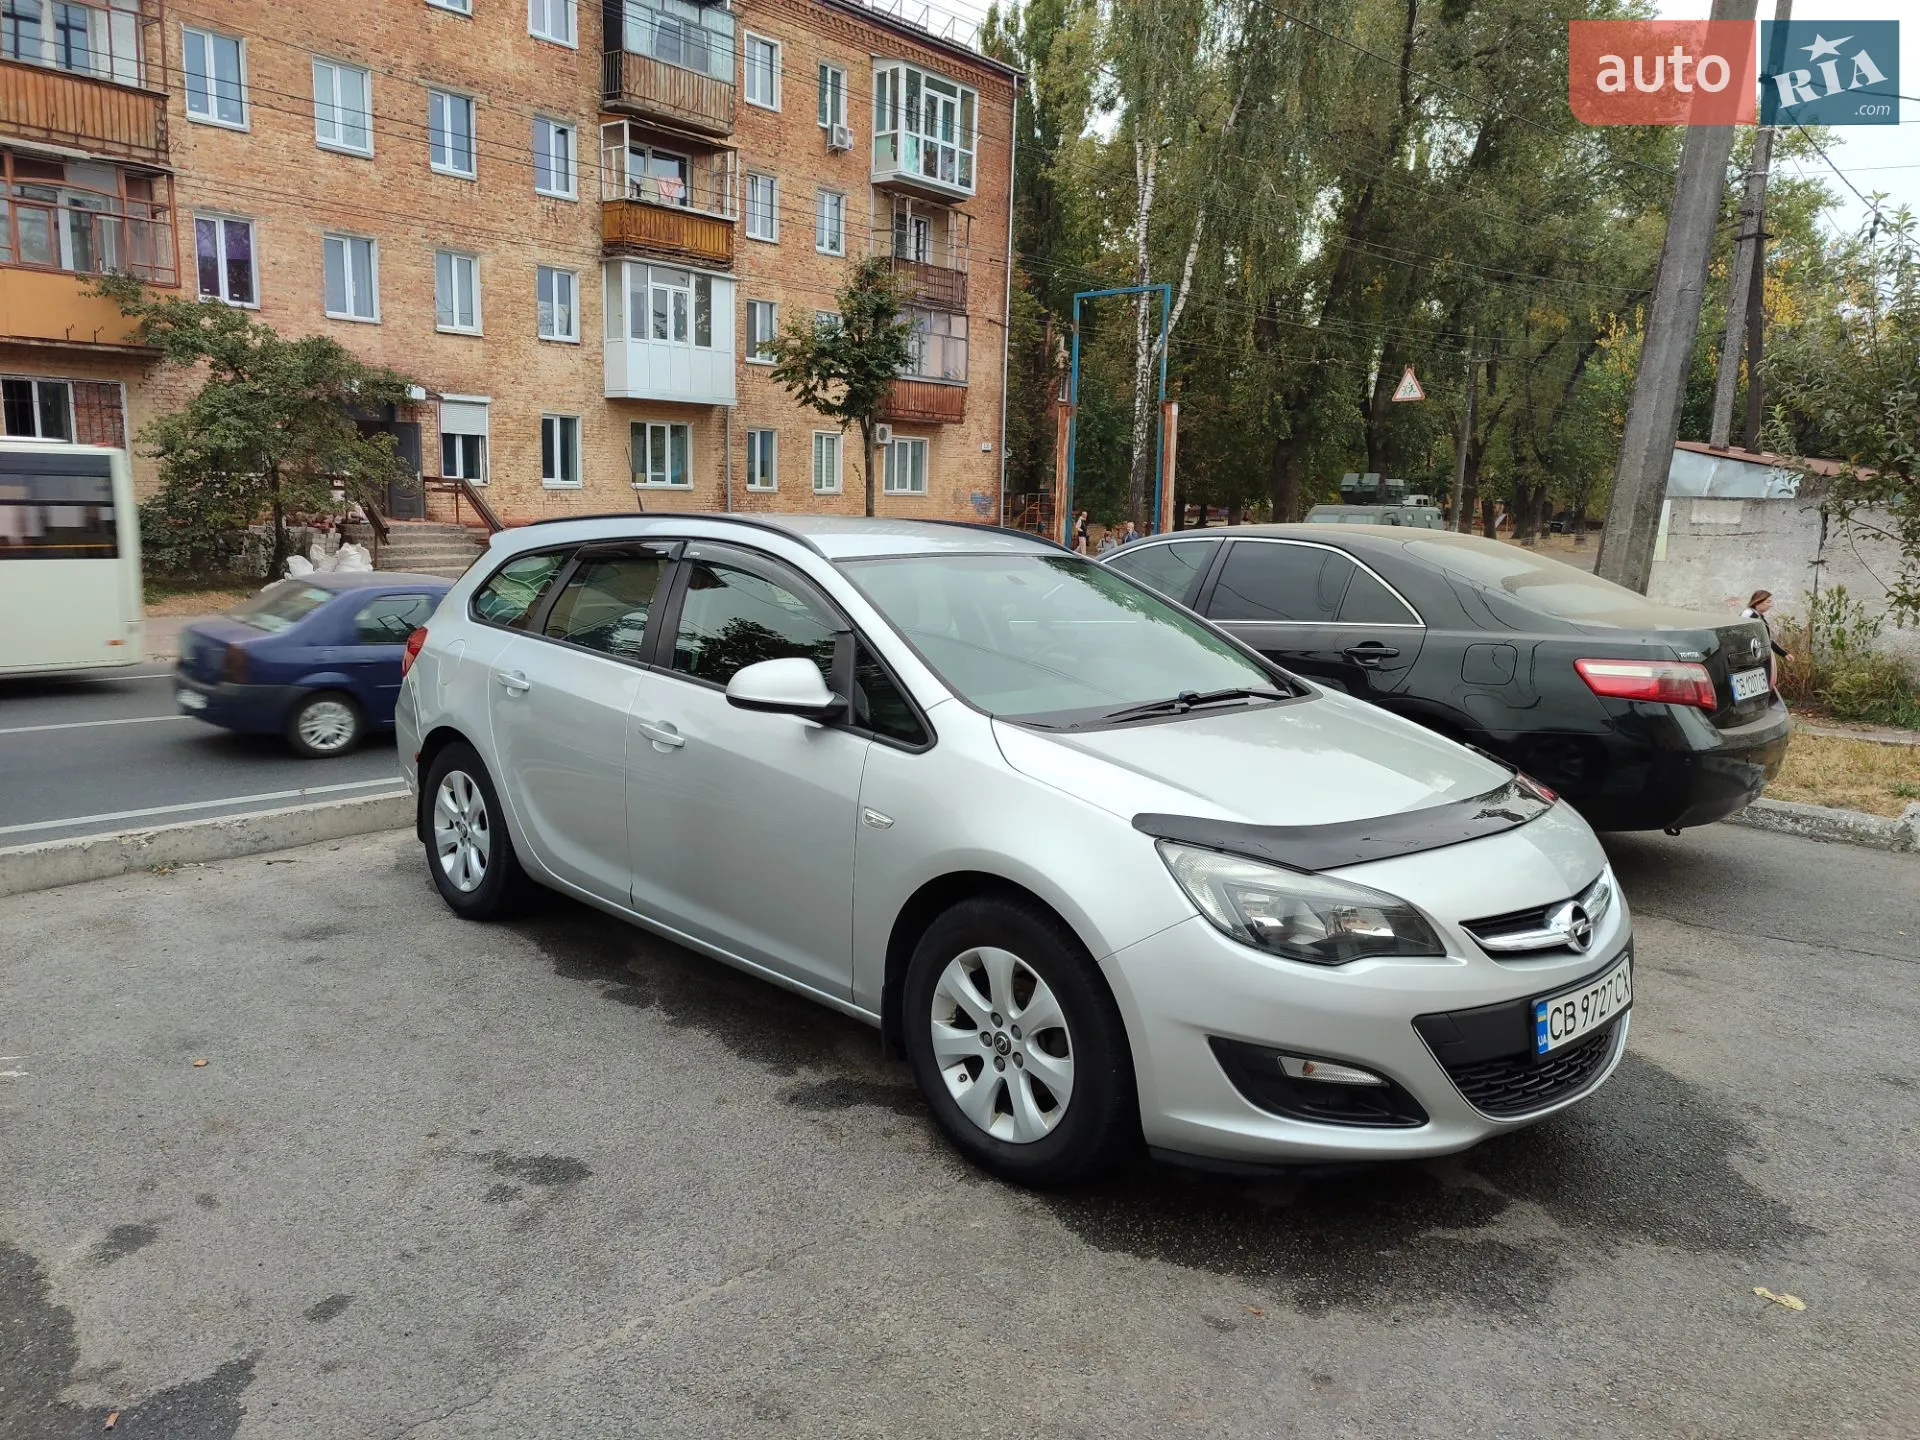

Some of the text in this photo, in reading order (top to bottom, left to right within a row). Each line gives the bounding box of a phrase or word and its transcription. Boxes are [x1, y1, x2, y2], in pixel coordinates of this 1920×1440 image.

[1550, 965, 1630, 1040] CB 9727 CX
[1538, 1034, 1547, 1046] UA
